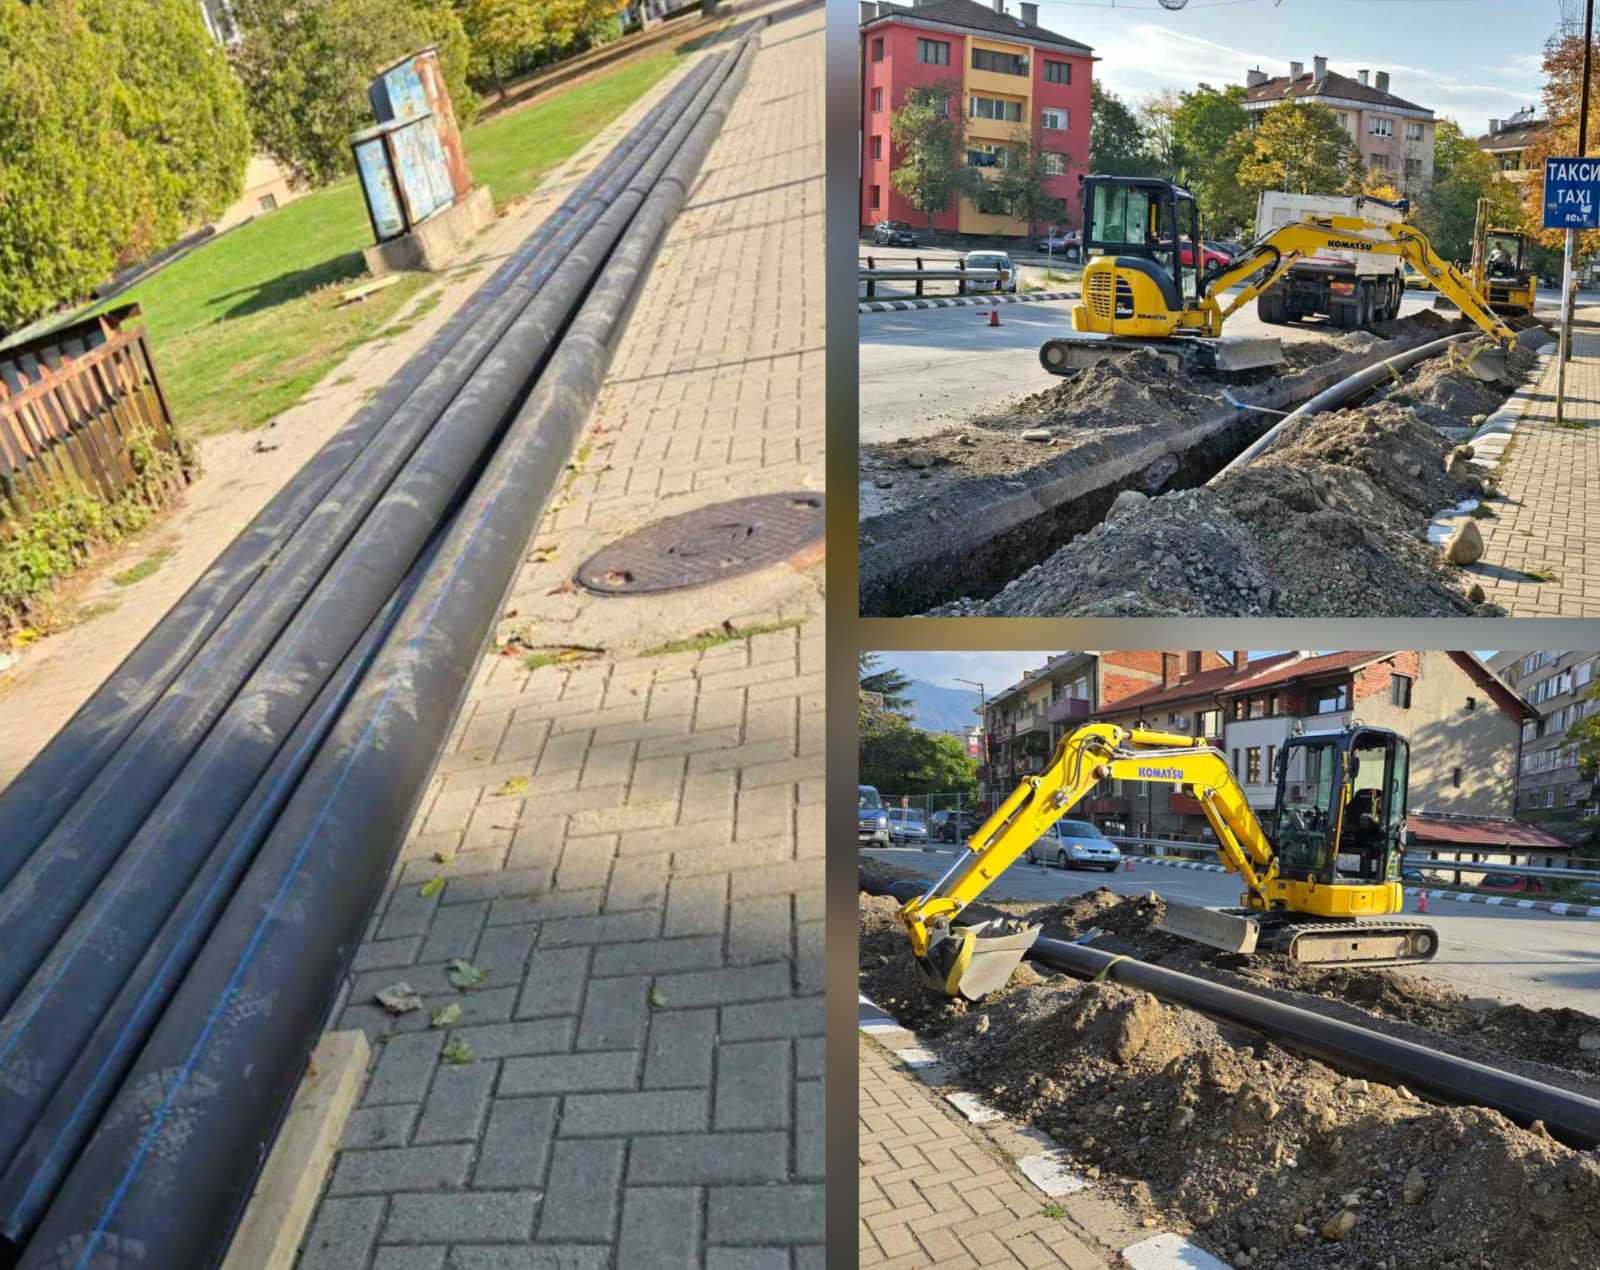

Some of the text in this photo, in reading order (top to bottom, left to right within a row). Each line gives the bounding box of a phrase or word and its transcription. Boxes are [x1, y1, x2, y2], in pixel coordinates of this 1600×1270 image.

[1548, 163, 1600, 181] ТАКСИ
[1557, 189, 1591, 204] TAXI
[1327, 239, 1373, 251] KOMATSU
[1138, 766, 1183, 779] KOMATSU
